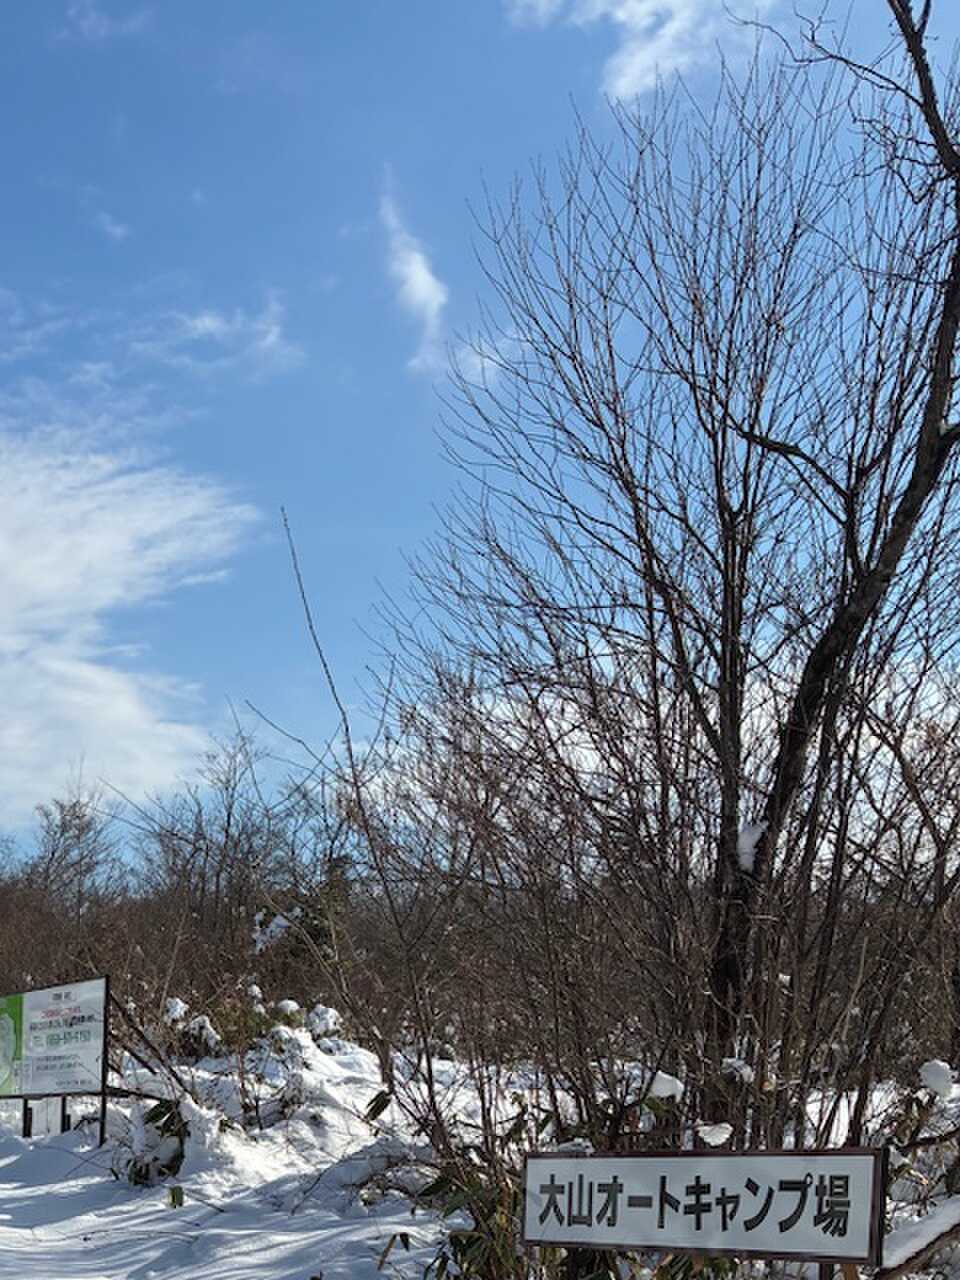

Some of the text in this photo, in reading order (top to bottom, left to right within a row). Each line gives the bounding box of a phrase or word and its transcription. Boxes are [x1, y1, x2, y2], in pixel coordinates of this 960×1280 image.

[539, 1172, 850, 1237] 大山オートキャンプ場
